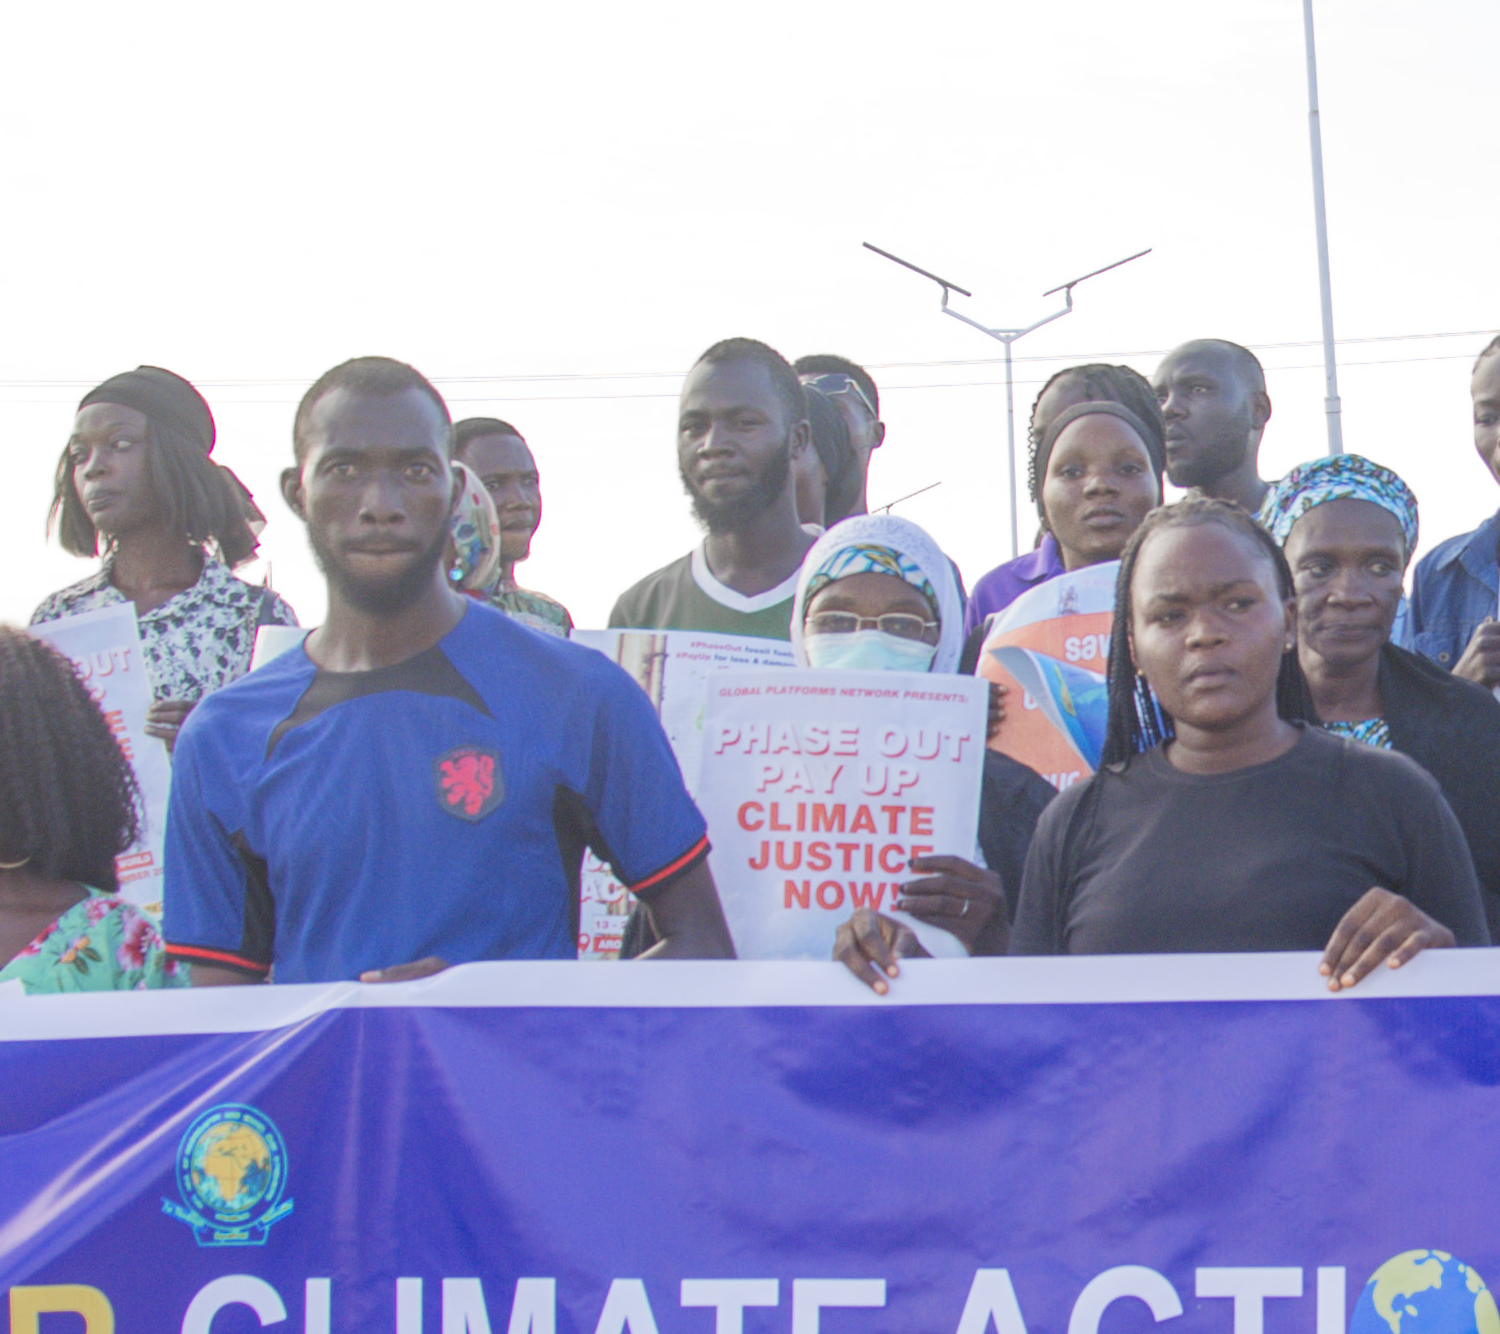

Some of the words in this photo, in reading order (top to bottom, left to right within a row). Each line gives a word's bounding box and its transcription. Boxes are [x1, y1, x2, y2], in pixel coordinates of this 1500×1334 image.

[719, 686, 761, 697] GLOBAL
[765, 686, 836, 696] PLATFORMS
[840, 688, 899, 699] NETWORK
[903, 691, 969, 703] PRESENTS:
[715, 722, 859, 756] PHASE
[878, 725, 971, 762] OUT
[756, 763, 844, 794] PAY
[860, 764, 919, 797] UP
[737, 801, 934, 836] CLIMATE
